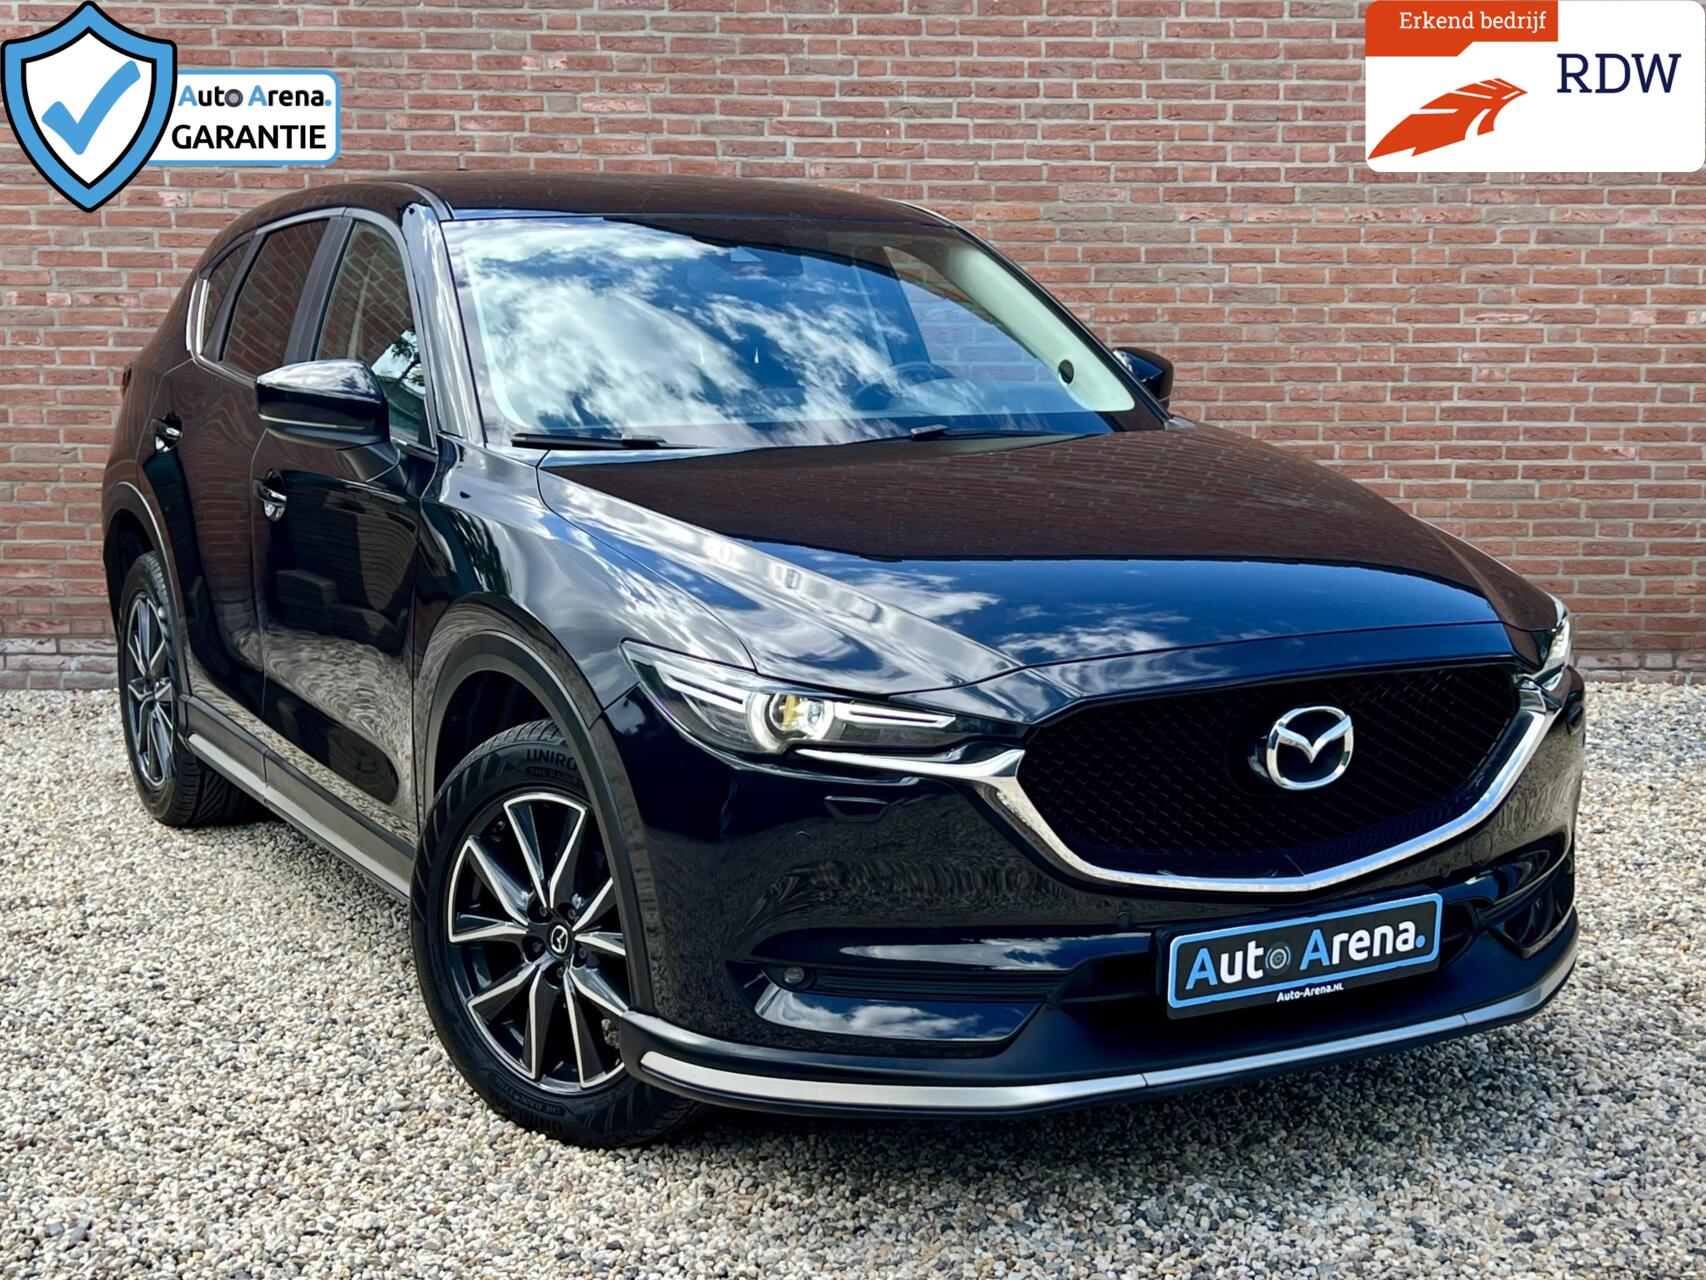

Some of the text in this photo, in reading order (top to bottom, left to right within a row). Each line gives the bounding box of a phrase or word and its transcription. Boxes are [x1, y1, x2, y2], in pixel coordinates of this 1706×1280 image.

[1185, 920, 1426, 990] Auto Arena.
[1276, 982, 1344, 1002] Auto-Arena.NL
